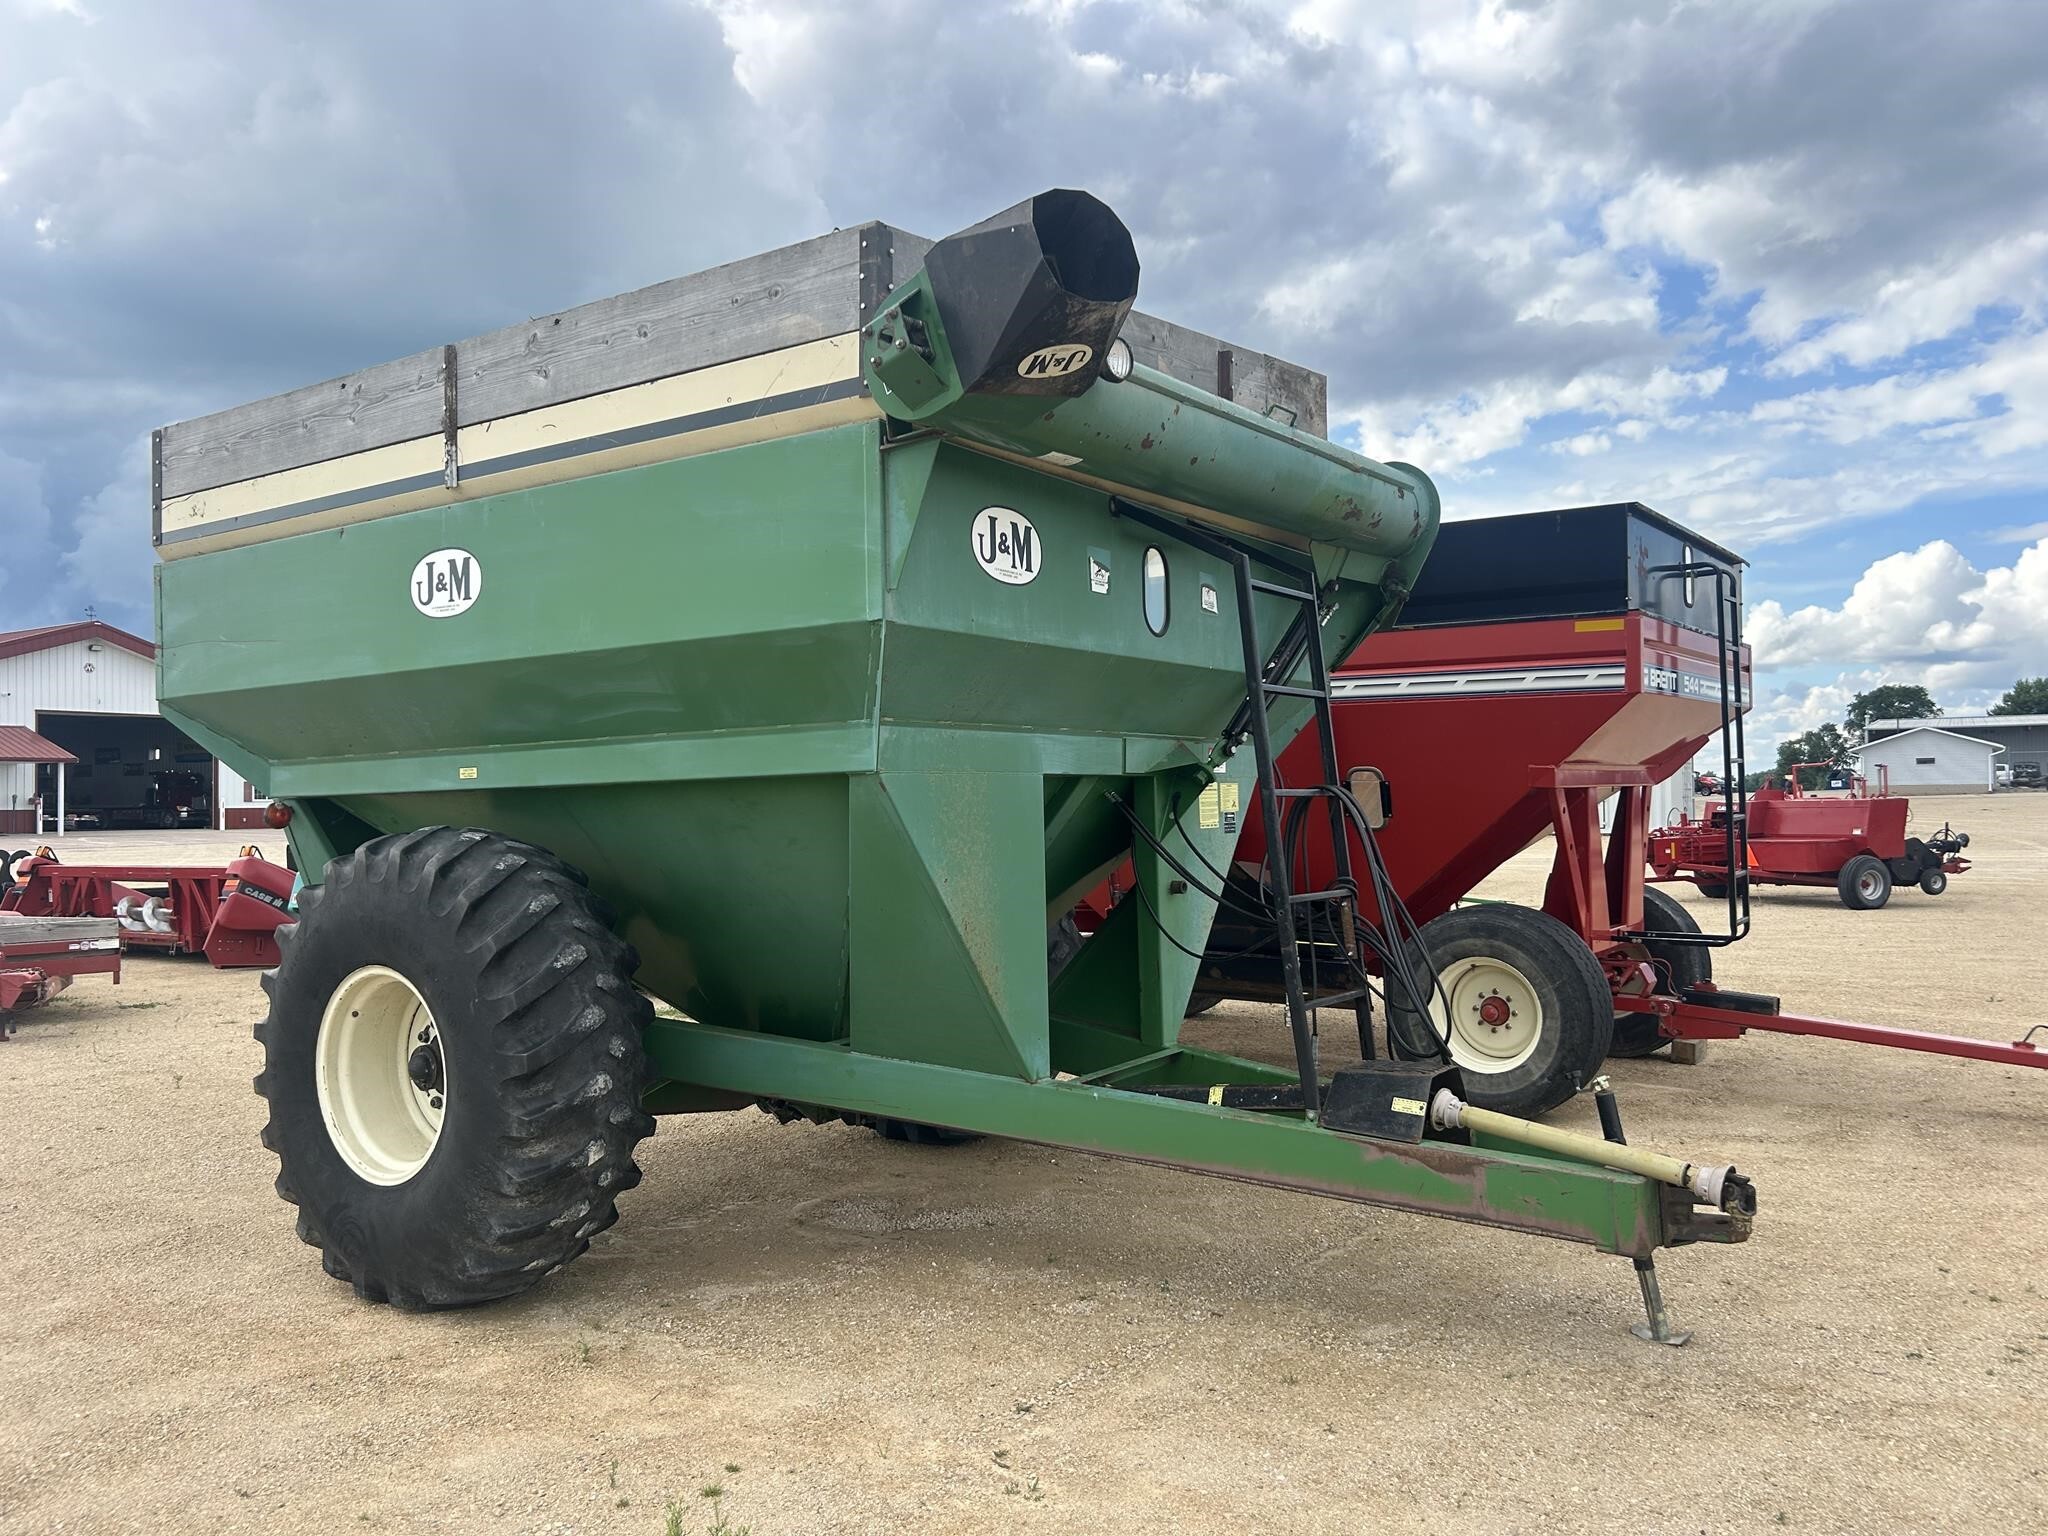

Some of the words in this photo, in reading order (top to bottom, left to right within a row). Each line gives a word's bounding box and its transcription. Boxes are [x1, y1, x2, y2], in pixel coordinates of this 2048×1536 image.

[1023, 350, 1087, 376] J&M
[977, 515, 1034, 573] J&M
[416, 556, 472, 606] J&M
[1650, 668, 1677, 691] BRENT
[1683, 675, 1699, 694] 544
[244, 887, 273, 904] CASE
